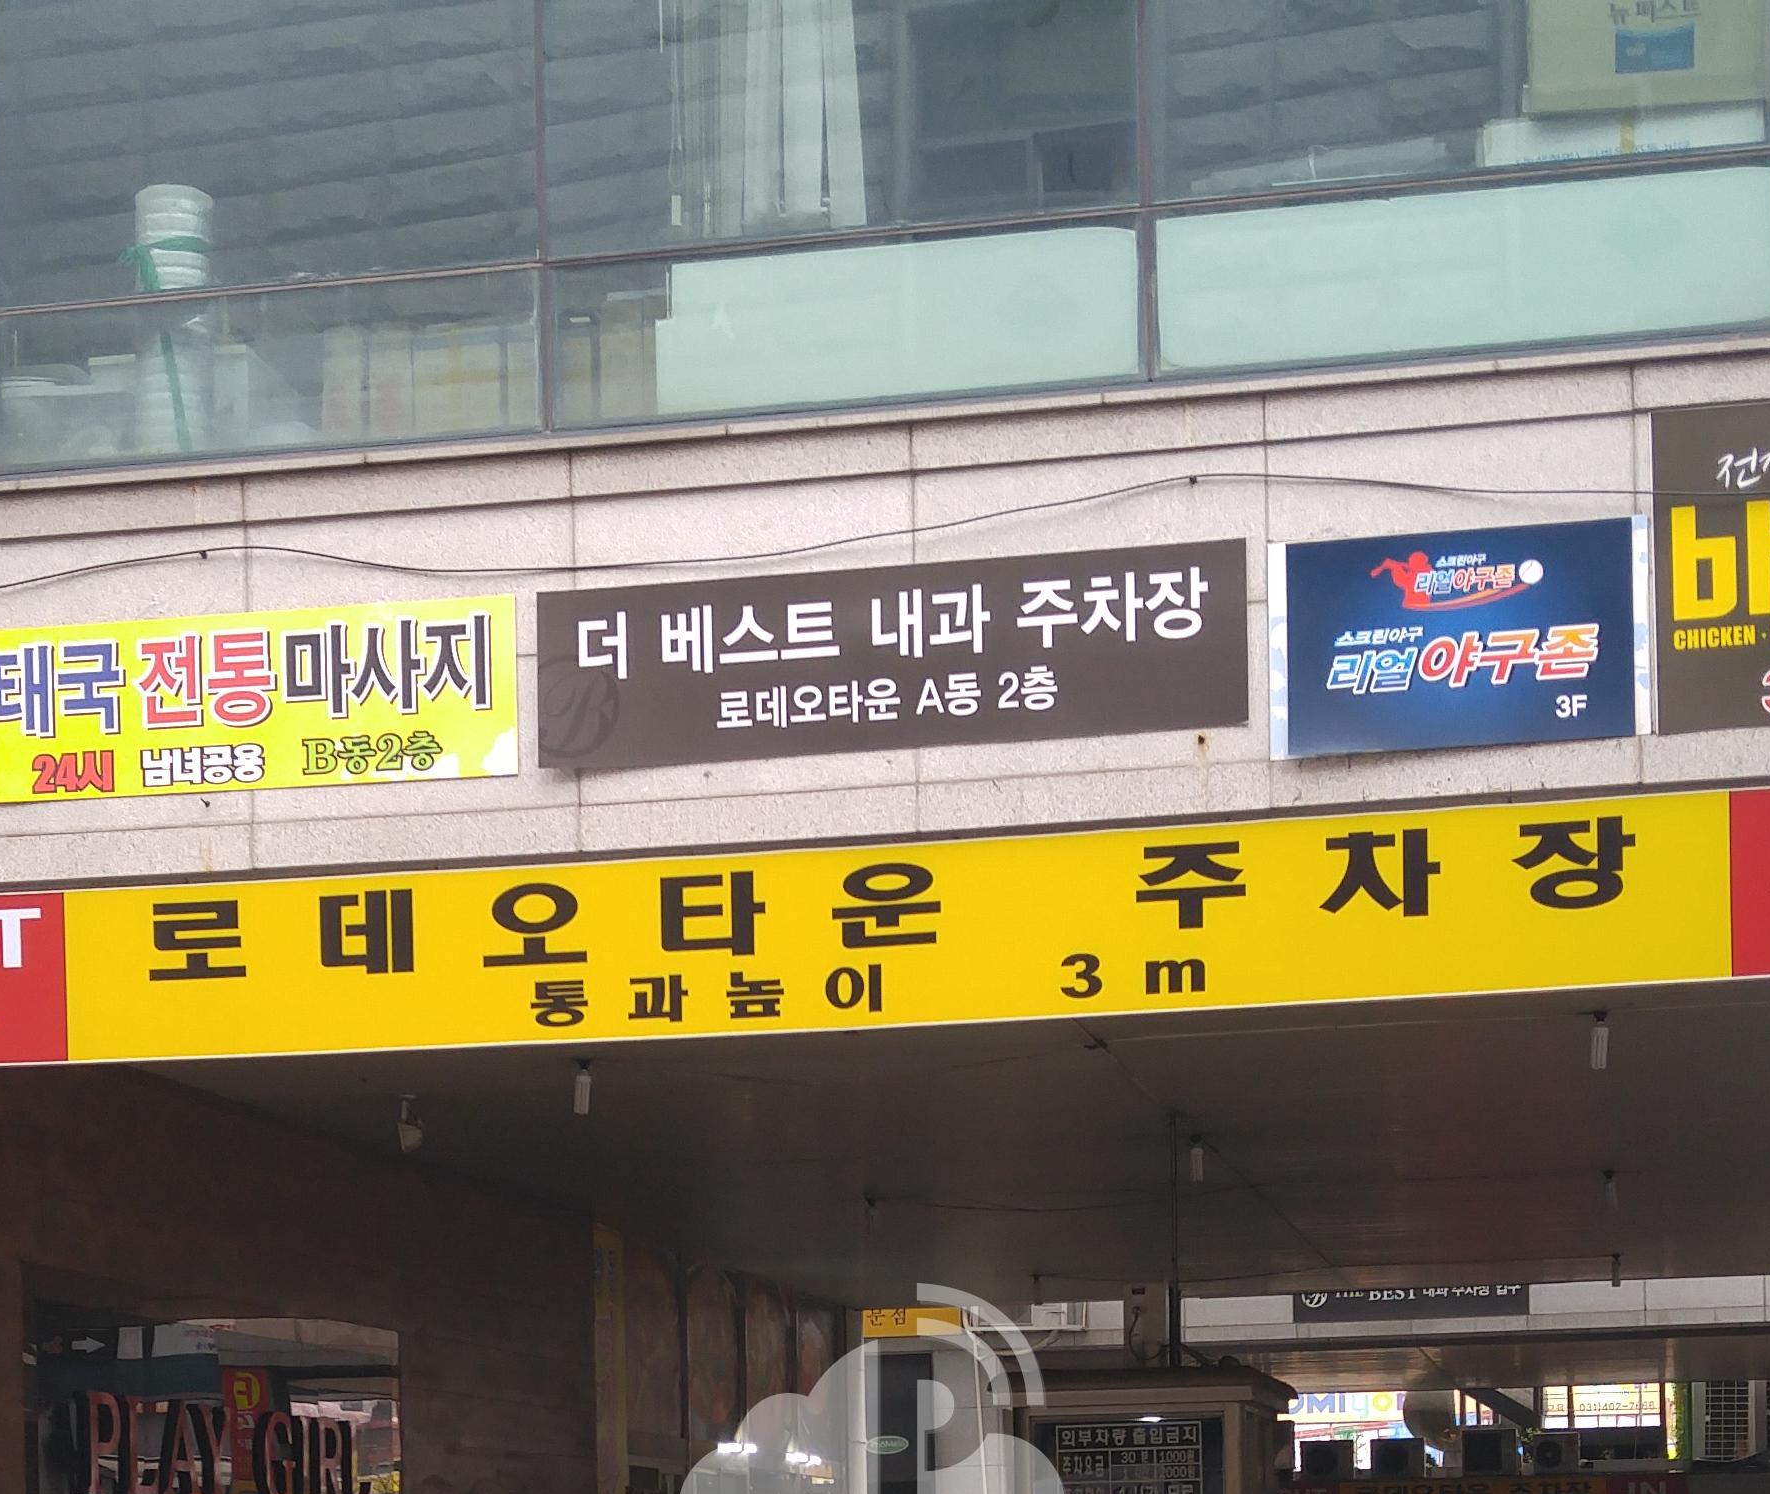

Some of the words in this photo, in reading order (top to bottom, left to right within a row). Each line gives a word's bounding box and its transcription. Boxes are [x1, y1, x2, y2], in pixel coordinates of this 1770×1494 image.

[1435, 553, 1487, 568] 스크린야구
[1414, 564, 1515, 594] 리얼야구존
[578, 609, 629, 681] 더
[660, 601, 842, 675] 베스트
[870, 582, 989, 659] 내과
[1016, 564, 1210, 643] 주차장
[1334, 625, 1424, 647] 스크린야구
[1673, 624, 1756, 651] CHICKEN
[1326, 623, 1599, 695] 리얼야구존
[716, 679, 901, 731] 로데오타운
[916, 670, 982, 717] A동
[998, 663, 1060, 713] 2층
[1555, 694, 1588, 718] 3F
[32, 751, 115, 794] 24시
[141, 743, 266, 786] 남녀공용
[303, 733, 442, 779] B동2층
[149, 862, 942, 982] 로데오타운
[1136, 816, 1635, 929] 주차장
[530, 962, 883, 1028] 통과높이
[1061, 1428, 1126, 1447] 외부차량
[1132, 1426, 1197, 1445] 출입금지
[1062, 1455, 1105, 1477] 주차요금
